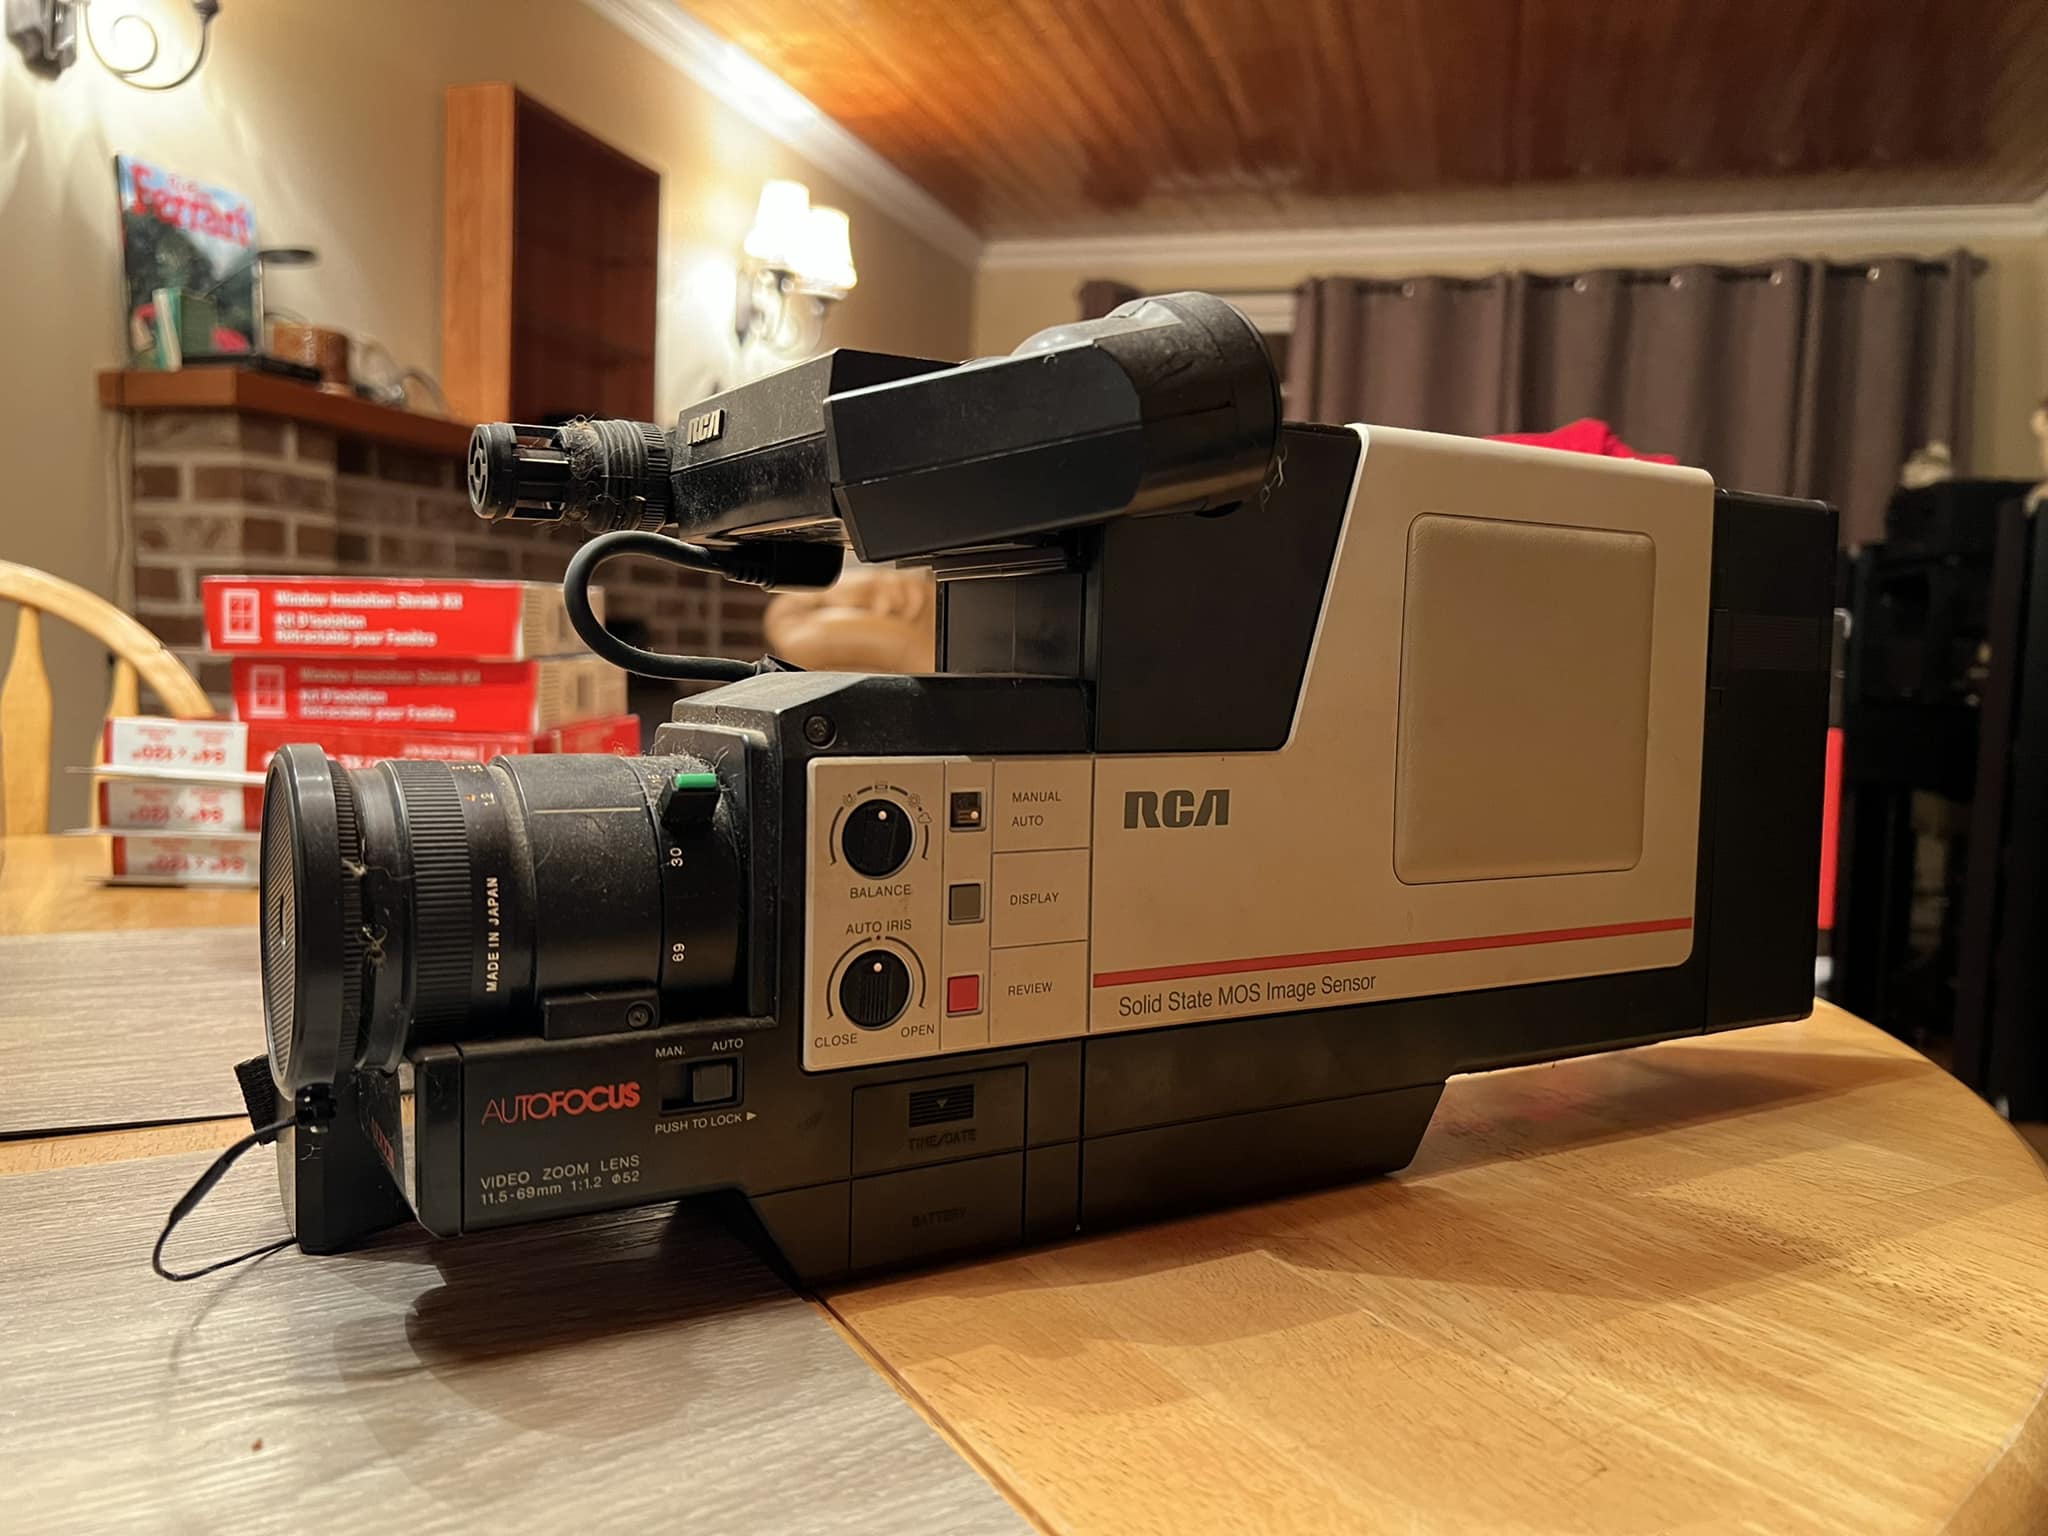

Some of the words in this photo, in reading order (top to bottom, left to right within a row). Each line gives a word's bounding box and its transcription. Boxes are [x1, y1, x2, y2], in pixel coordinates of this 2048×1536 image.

[687, 409, 721, 444] RCA
[1012, 792, 1061, 802] MANUAL
[1124, 789, 1230, 829] RCA
[1012, 815, 1044, 827] AUTO
[670, 847, 683, 867] 30
[850, 884, 912, 899] BALANCE
[1010, 892, 1060, 906] DISPLAY
[486, 877, 499, 926] JAPAN
[845, 921, 882, 935] AUTO
[886, 919, 912, 932] IRIS
[488, 931, 499, 947] IN
[672, 943, 685, 962] 69
[486, 952, 499, 992] MADE
[1008, 982, 1053, 996] REVIEW
[1119, 994, 1162, 1016] Solid
[1168, 990, 1212, 1011] State
[1218, 983, 1261, 1006] MOS
[1266, 980, 1316, 1001] Image
[1321, 975, 1377, 993] Sensor
[901, 1024, 935, 1038] OPEN
[711, 1038, 744, 1051] AUTO
[814, 1033, 858, 1049] CLOSE
[655, 1045, 685, 1058] MAN.
[481, 1081, 640, 1126] AUTOFOCUS
[655, 1120, 688, 1134] PUSH
[692, 1118, 708, 1128] TO
[710, 1113, 743, 1127] LOCK
[908, 1128, 977, 1152] TIME/DATE
[480, 1170, 530, 1190] VIDEO
[542, 1162, 590, 1181] ZOOM
[600, 1154, 640, 1172] LENS
[571, 1176, 602, 1192] 1:1.2
